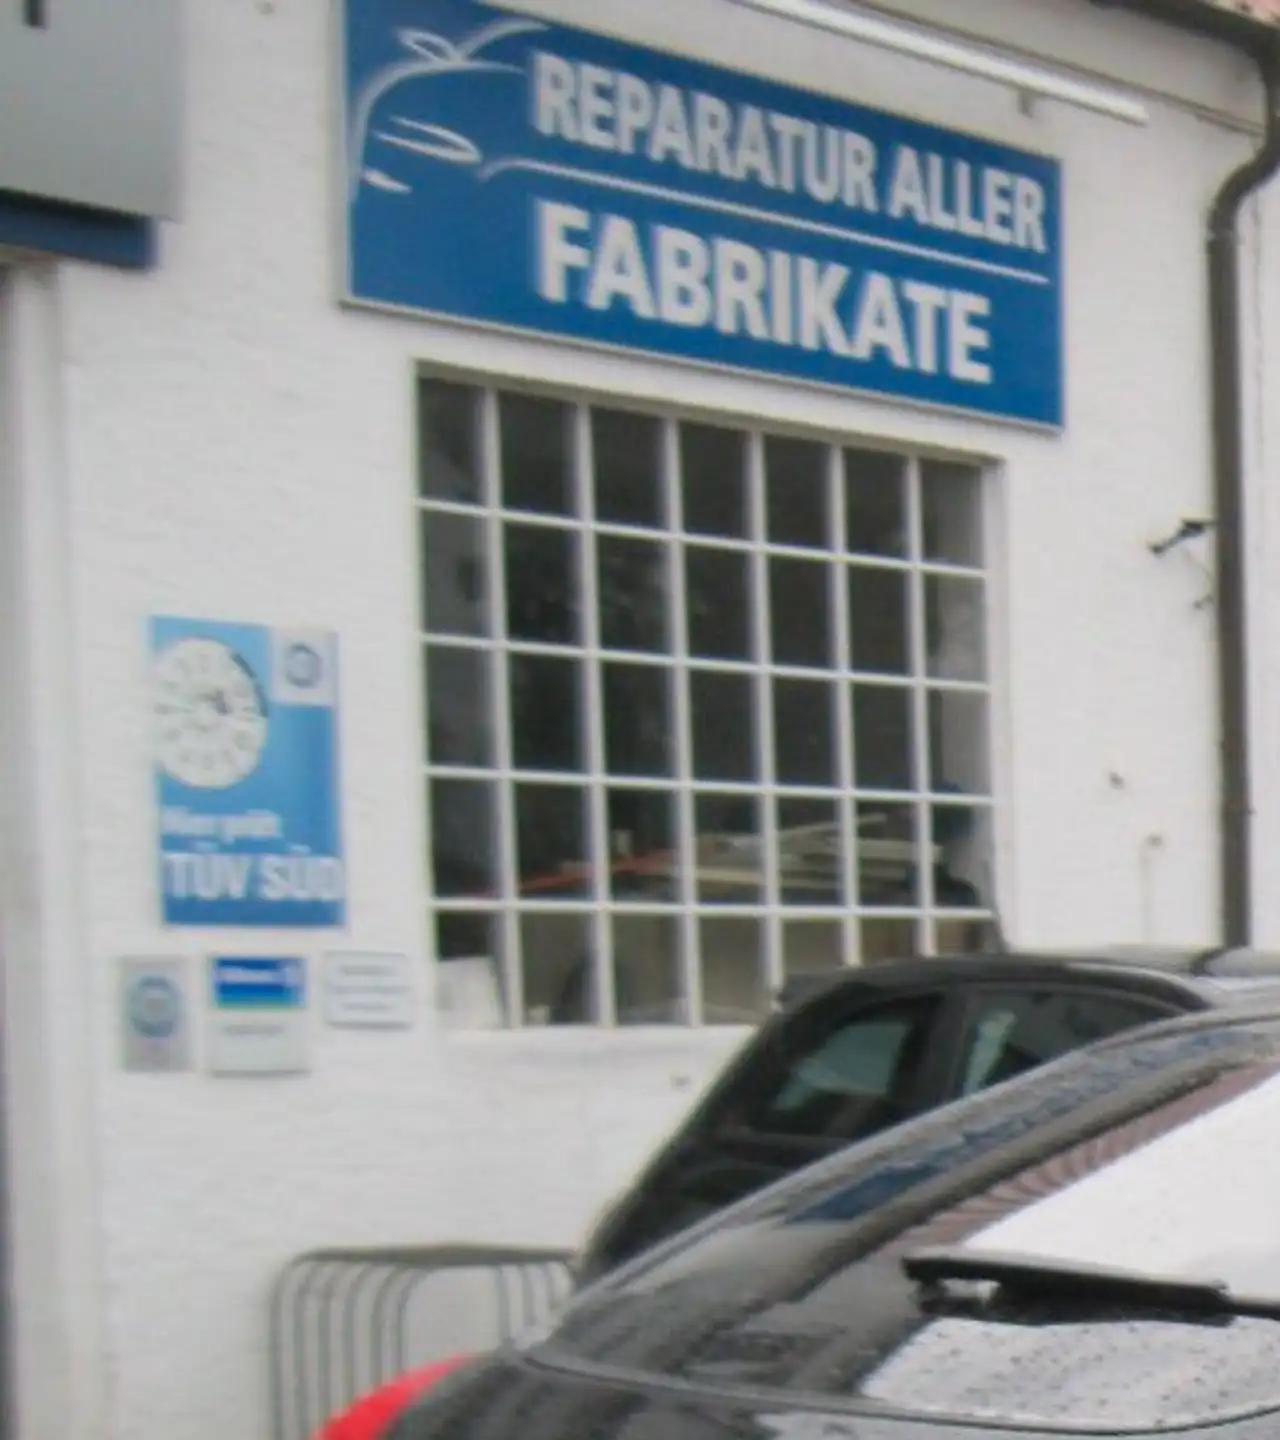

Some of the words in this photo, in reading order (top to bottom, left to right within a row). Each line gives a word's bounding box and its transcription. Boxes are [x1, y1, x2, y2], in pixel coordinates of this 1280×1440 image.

[531, 51, 877, 214] REPARATUR
[889, 144, 1047, 254] ALLER
[535, 200, 992, 385] FABRIKATE
